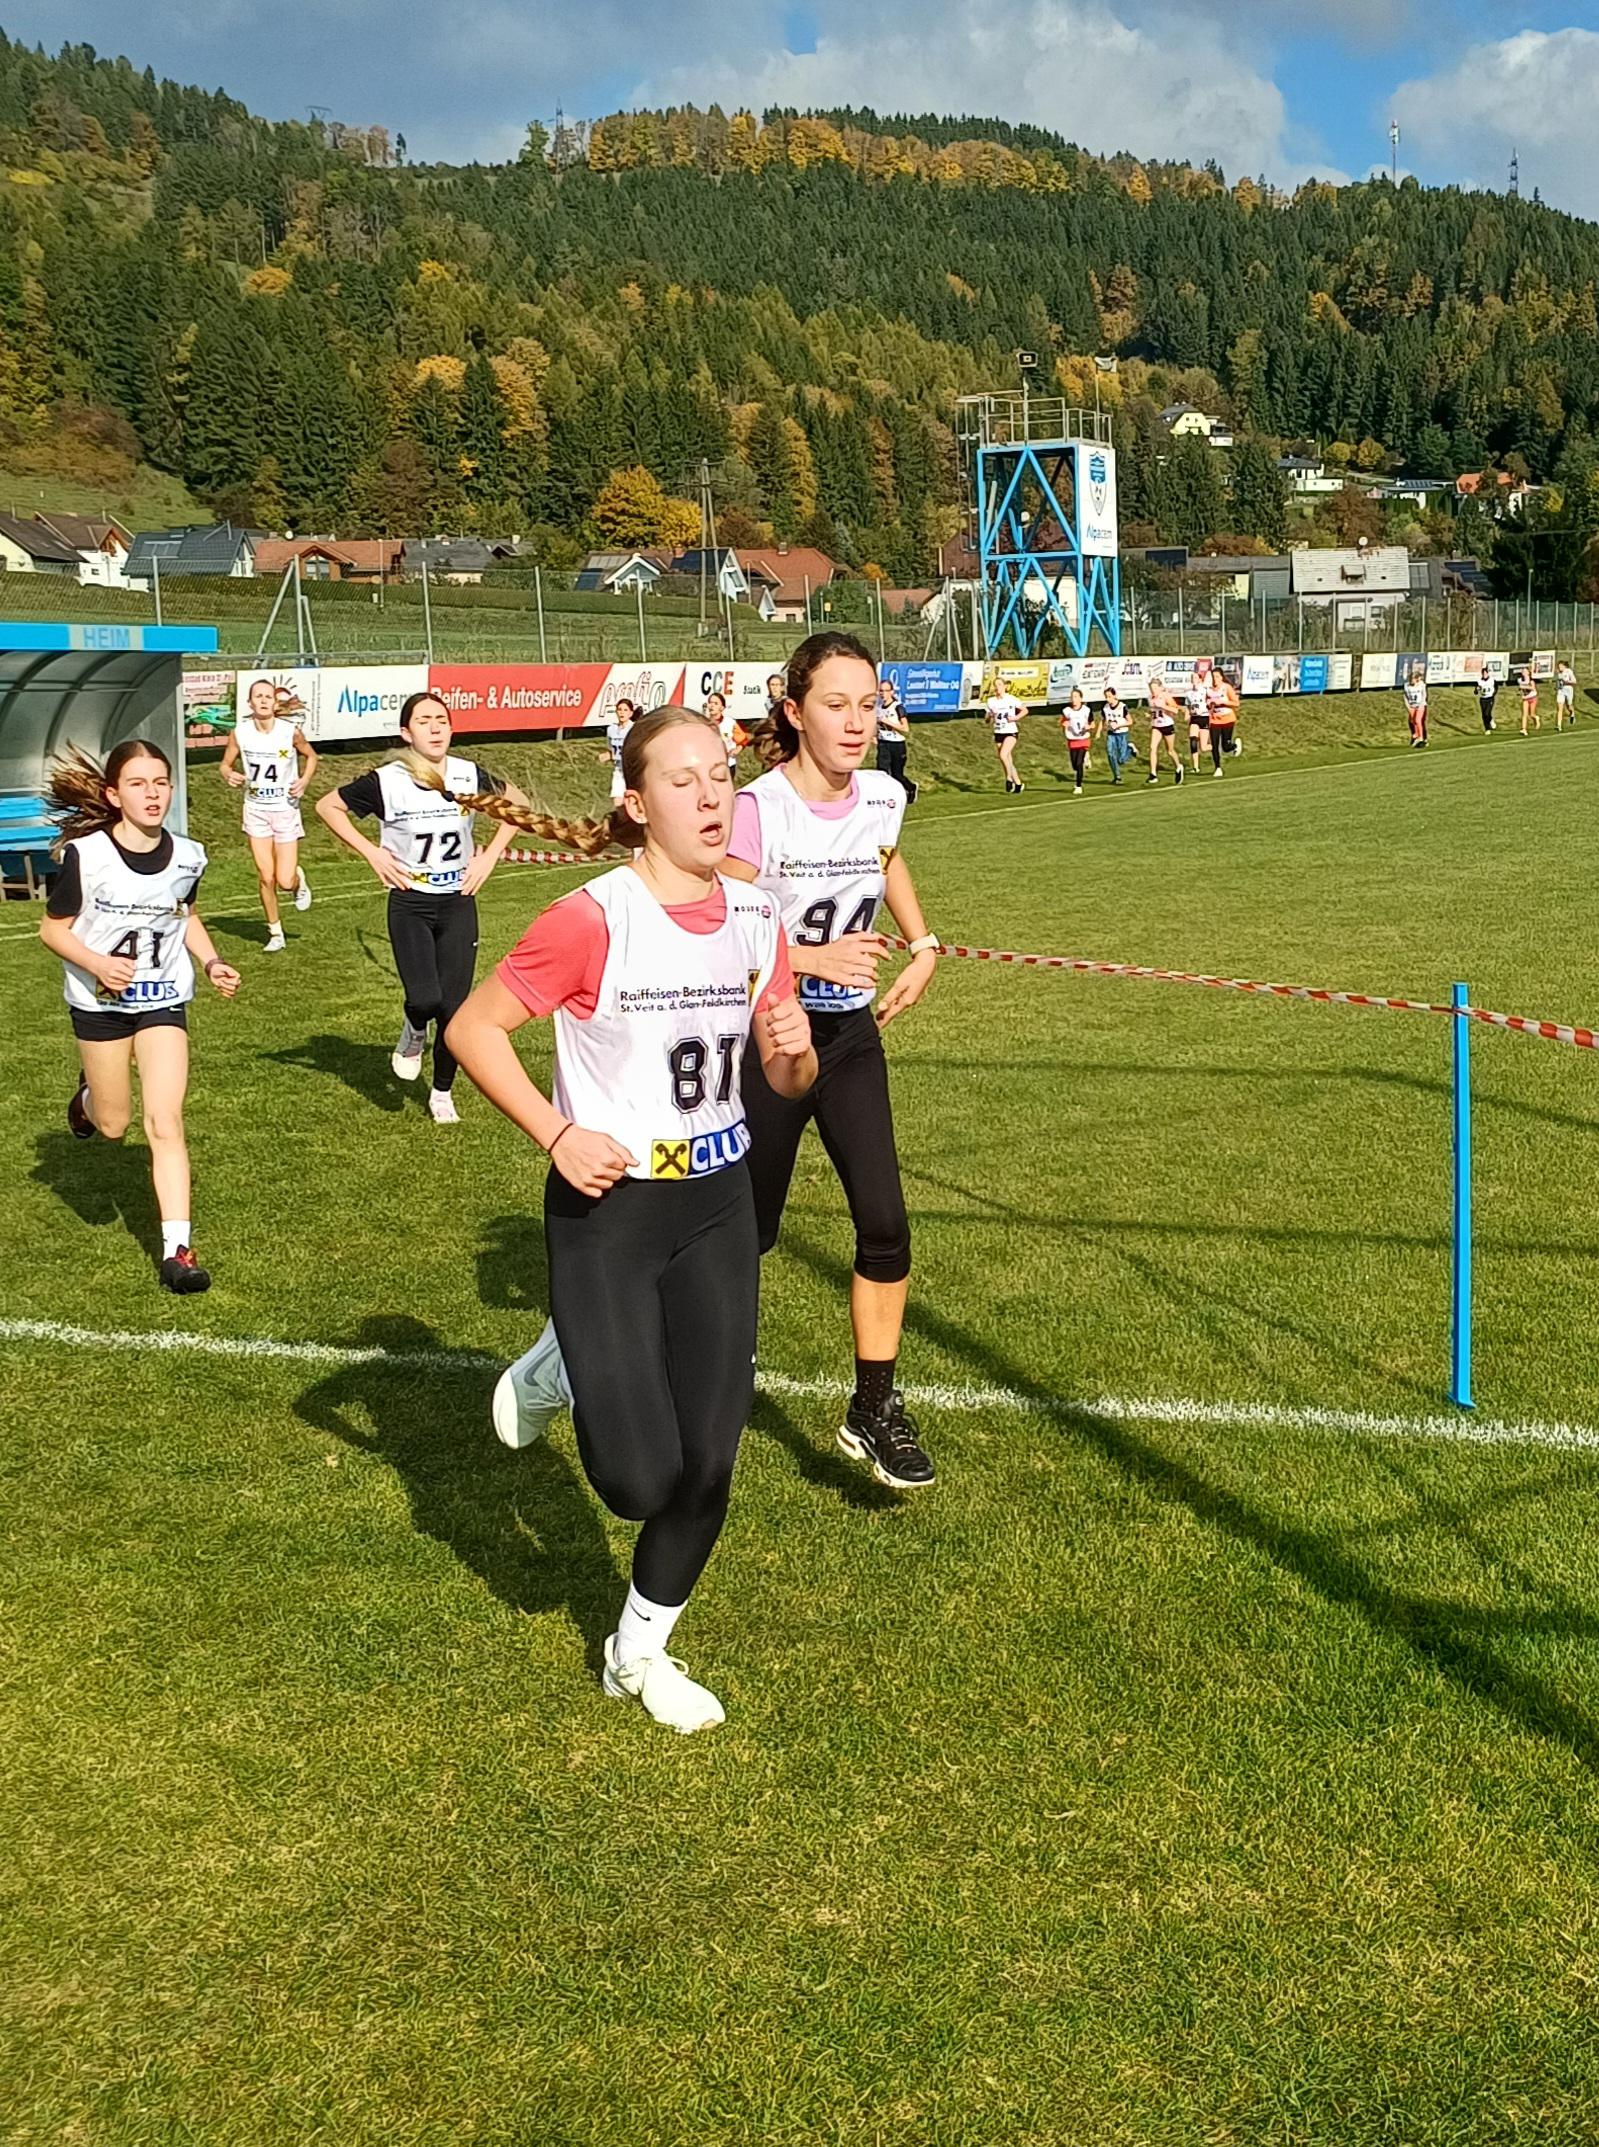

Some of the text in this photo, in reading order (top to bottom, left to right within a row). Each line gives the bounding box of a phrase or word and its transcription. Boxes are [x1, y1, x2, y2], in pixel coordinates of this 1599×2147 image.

[83, 627, 130, 648] HEIM
[701, 671, 735, 696] CCE
[487, 686, 499, 709] &
[501, 684, 582, 709] Autoservice
[250, 763, 278, 782] 74
[415, 832, 461, 863] 72
[794, 896, 880, 946] 94
[111, 930, 164, 967] 41
[620, 984, 746, 1002] Raiffeisen-Bezirksbank
[620, 1003, 634, 1013] St.
[634, 1002, 654, 1012] Veit
[668, 1034, 740, 1114] 81
